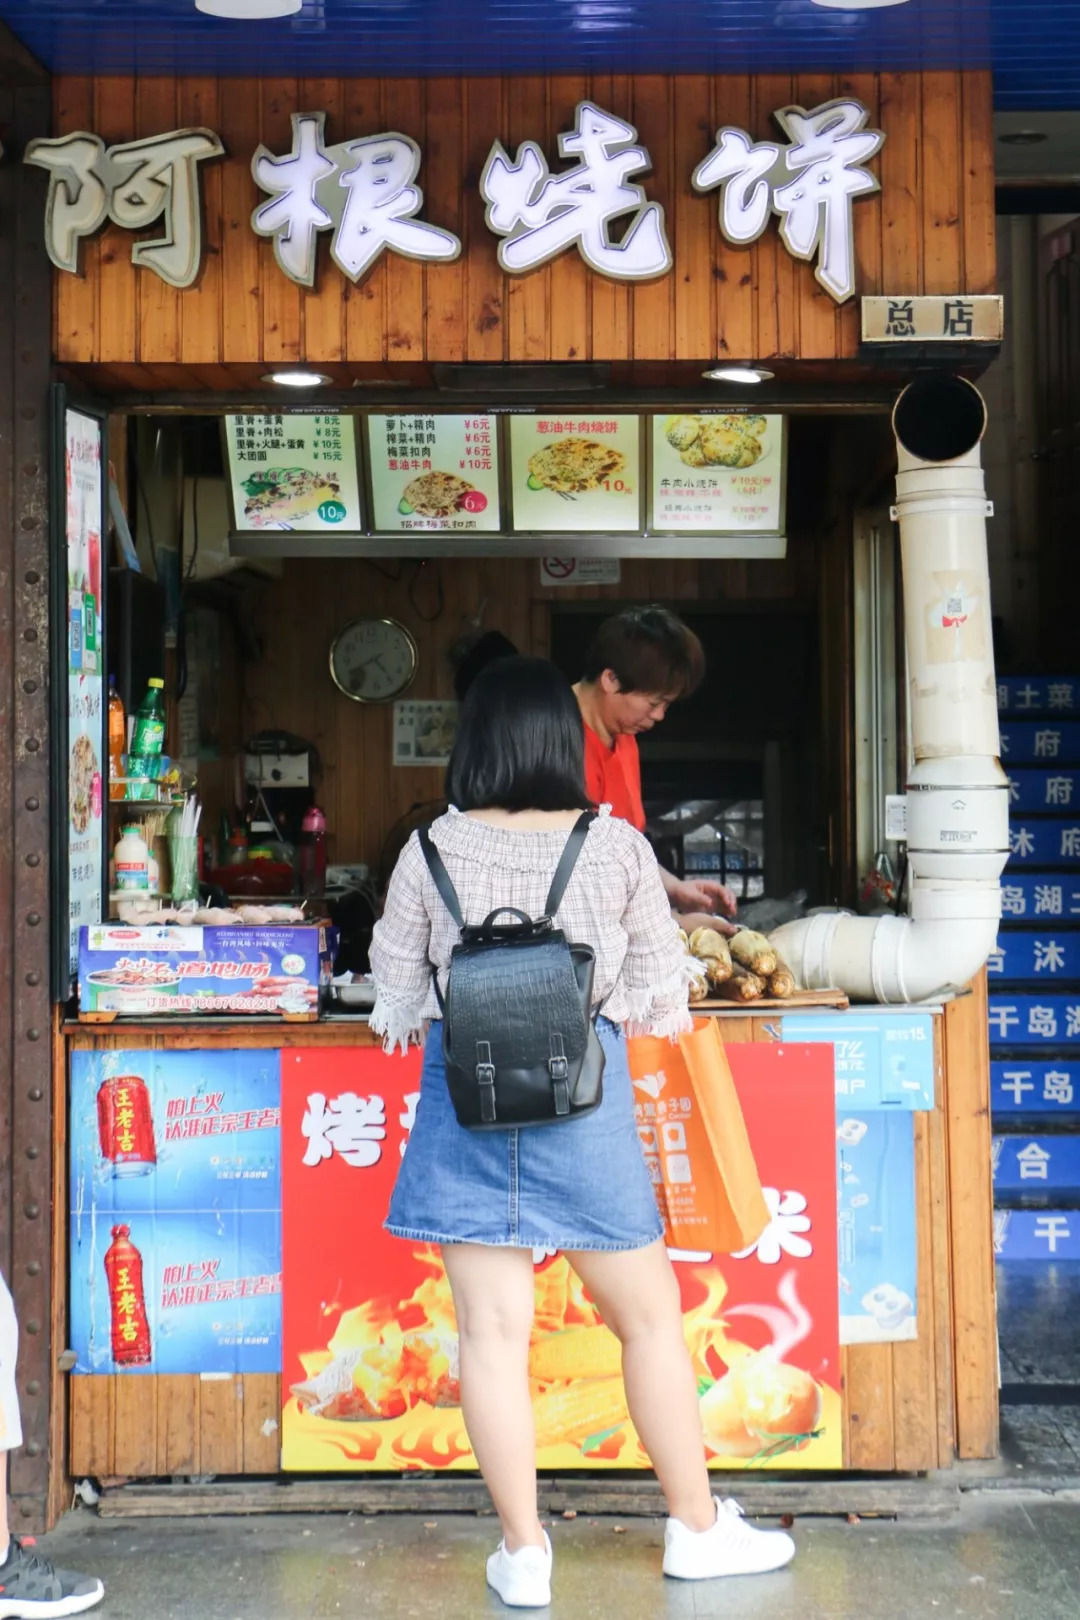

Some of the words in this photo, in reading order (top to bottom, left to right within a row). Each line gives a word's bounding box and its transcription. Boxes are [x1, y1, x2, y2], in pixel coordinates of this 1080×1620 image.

[23, 97, 887, 303] 阿根烧饼
[885, 301, 974, 337] 总店
[236, 427, 283, 437] 里脊+肉松
[536, 421, 618, 433] 葱油牛肉烧饼
[387, 447, 431, 457] 梅菜扣肉
[388, 460, 432, 470] 葱油牛肉
[177, 961, 272, 978] 道地肠
[115, 1088, 136, 1152] 王老吉
[166, 1091, 224, 1119] 怕上火
[301, 1091, 421, 1168] 烤
[1016, 1142, 1051, 1179] 合
[162, 1258, 220, 1286] 怕上火
[116, 1268, 139, 1342] 王老吉
[161, 1272, 281, 1311] 认准正宗王老
